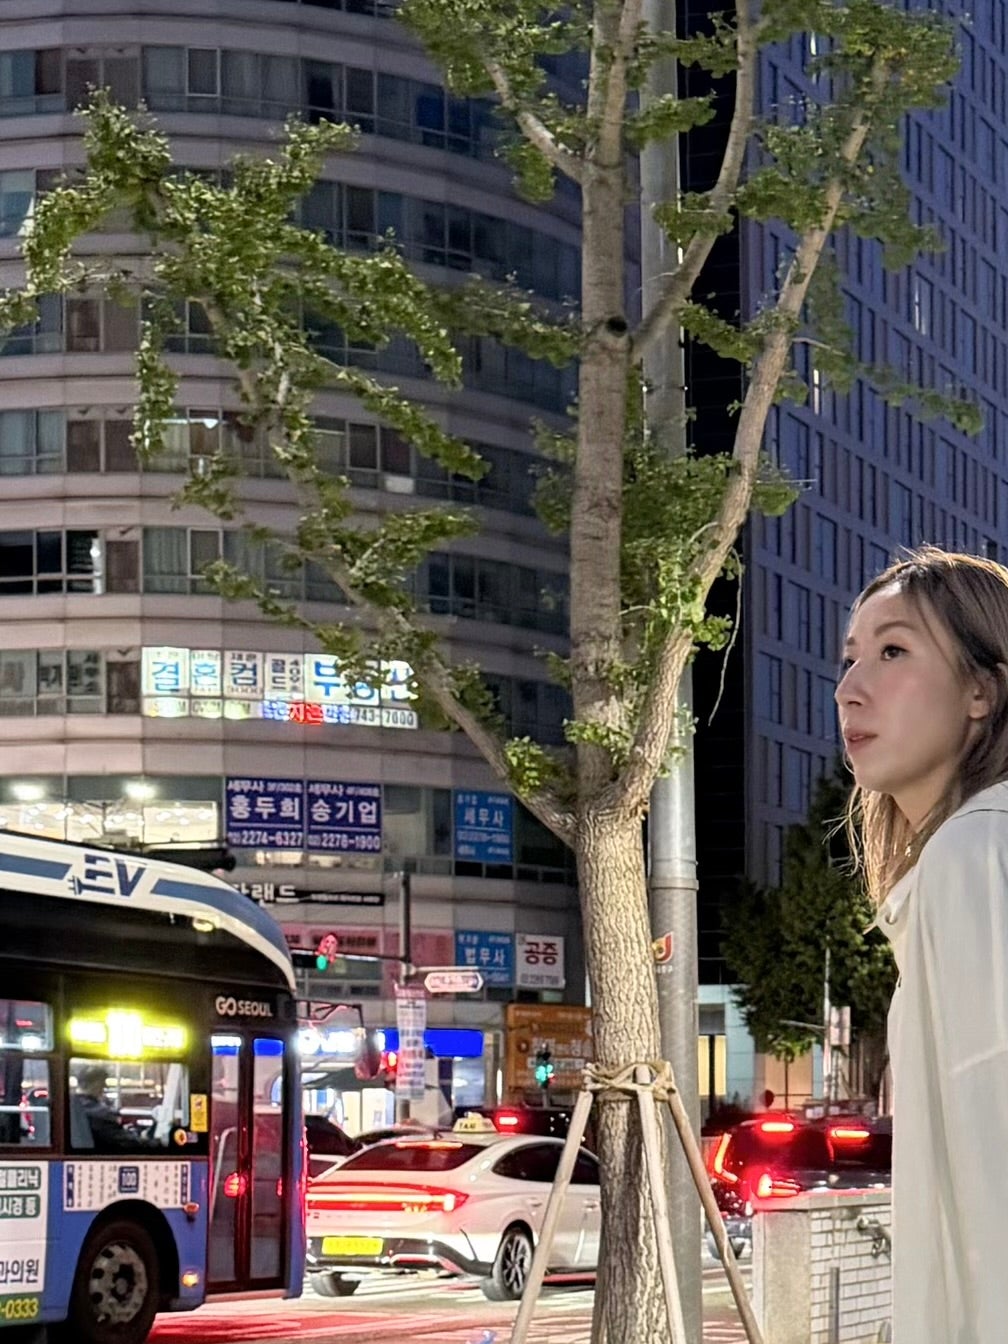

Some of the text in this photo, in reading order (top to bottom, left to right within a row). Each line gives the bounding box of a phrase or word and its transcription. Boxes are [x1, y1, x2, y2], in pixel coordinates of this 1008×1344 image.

[227, 780, 264, 793] 세무사
[309, 784, 343, 796] 세무사
[311, 799, 377, 824] 송기업
[68, 854, 147, 897] EV
[525, 942, 558, 965] 공증
[215, 995, 272, 1017] GO SEOUL
[121, 1172, 137, 1186] 100
[0, 1197, 23, 1216] 시경
